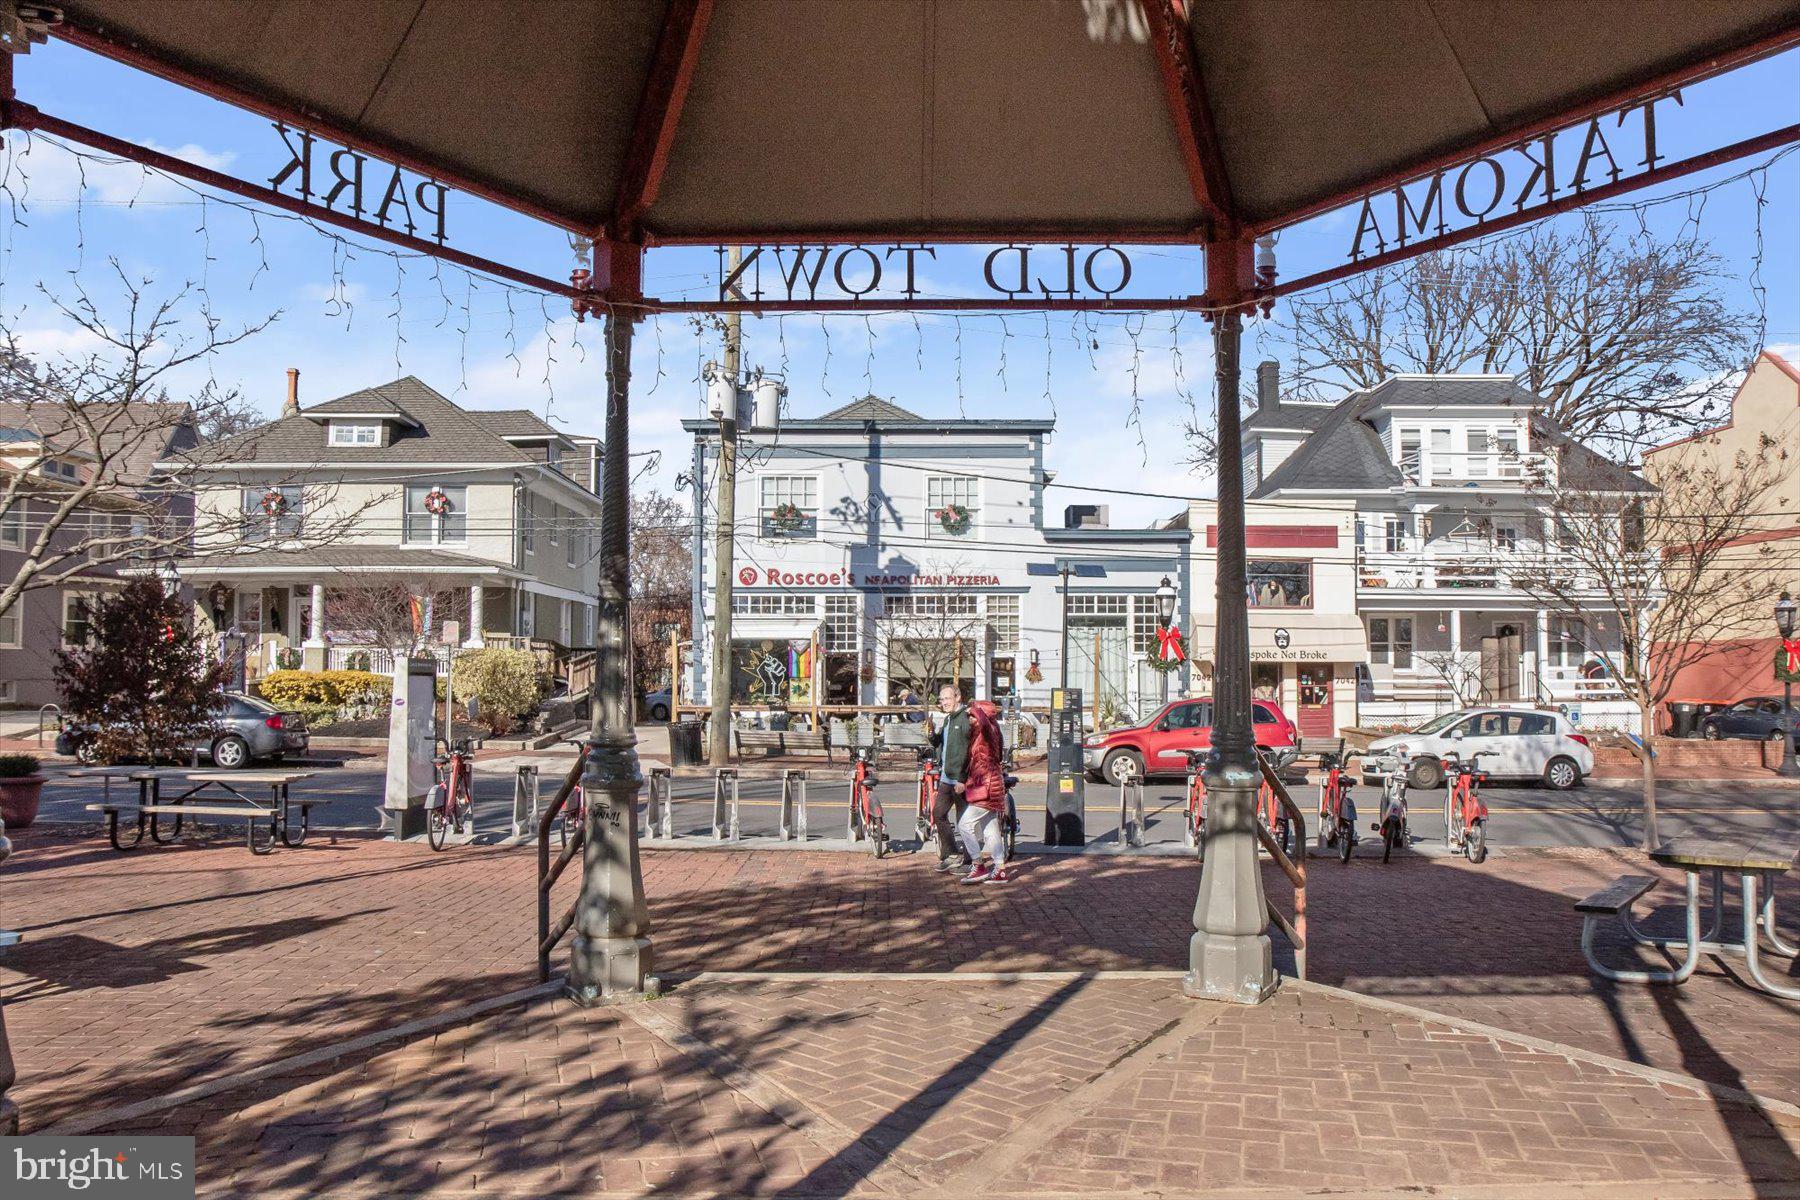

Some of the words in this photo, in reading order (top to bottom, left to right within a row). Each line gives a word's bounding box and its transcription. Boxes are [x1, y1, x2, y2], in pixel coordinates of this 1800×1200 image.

[767, 567, 855, 586] Roscoe's
[864, 575, 942, 585] NEAPOLITAN
[946, 575, 1000, 585] PIZZERIA
[1250, 650, 1278, 660] spoke
[1281, 651, 1297, 659] Not
[1300, 651, 1328, 659] Broke
